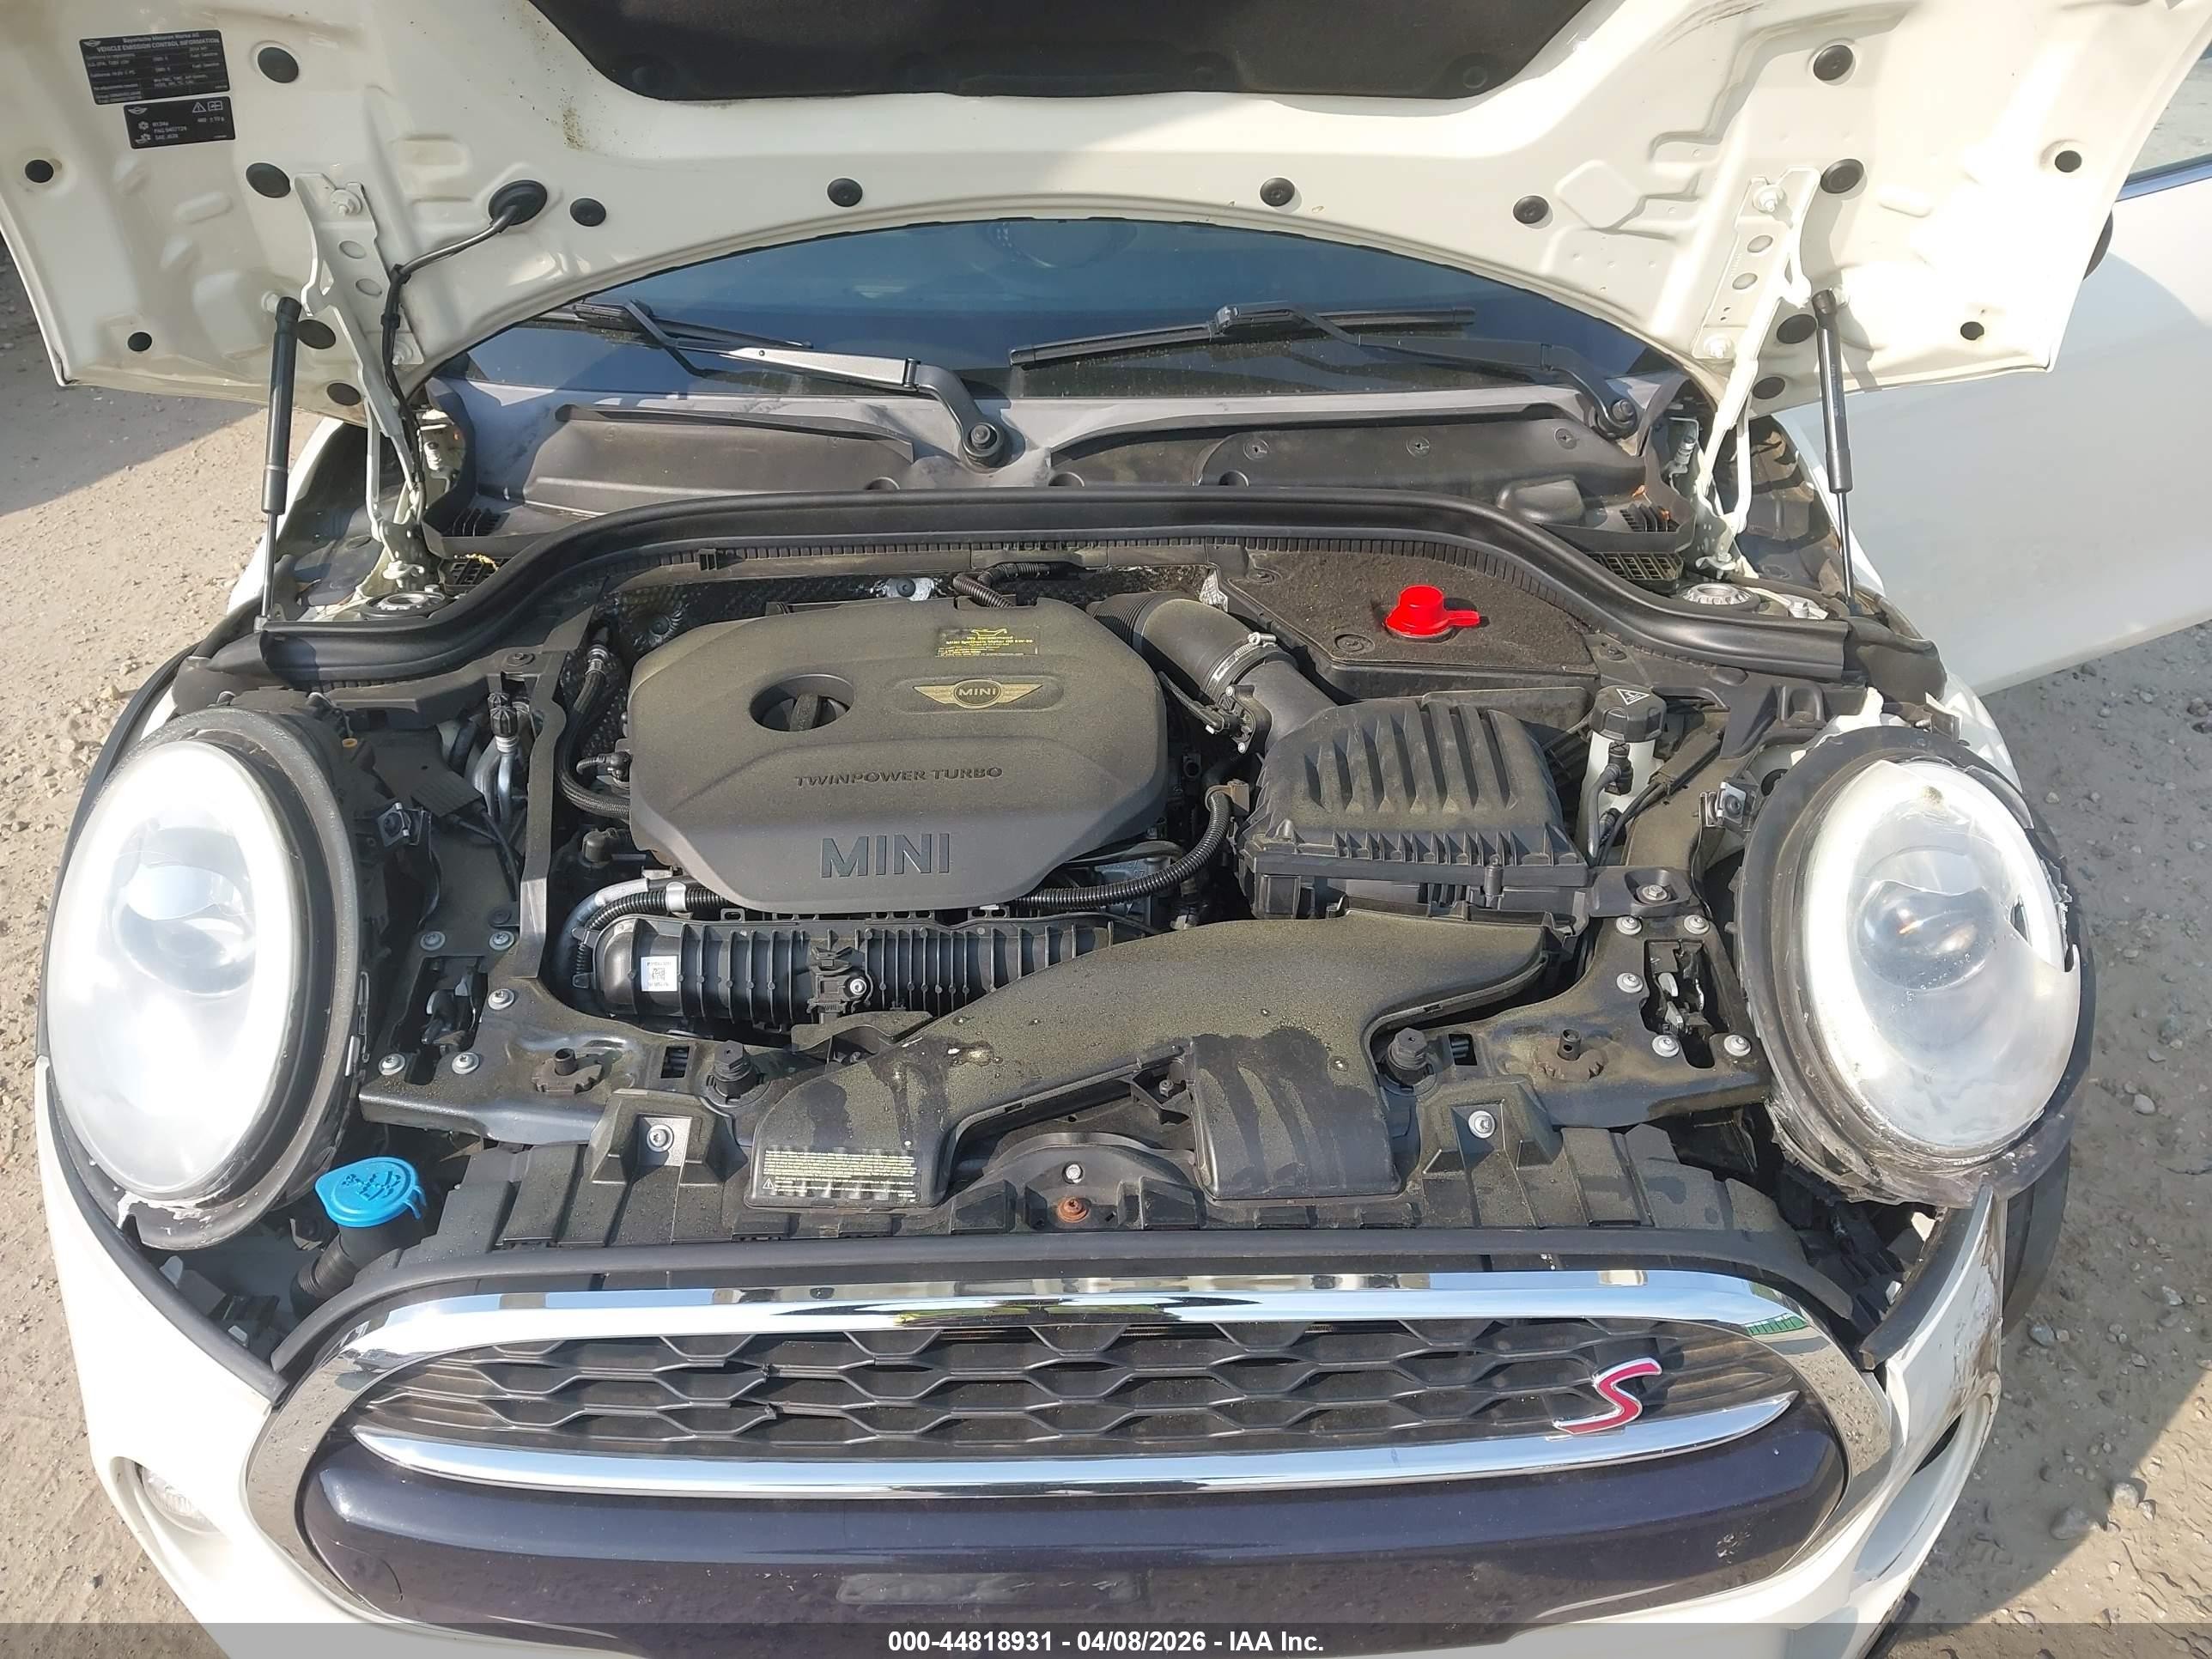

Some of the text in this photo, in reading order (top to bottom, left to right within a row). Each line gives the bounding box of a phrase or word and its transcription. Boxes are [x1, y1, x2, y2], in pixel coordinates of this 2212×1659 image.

[179, 38, 220, 46] INFORMATION
[795, 767, 1003, 787] TWINPOWER TURBO
[821, 833, 950, 878] MINI
[1553, 1357, 1662, 1435] S
